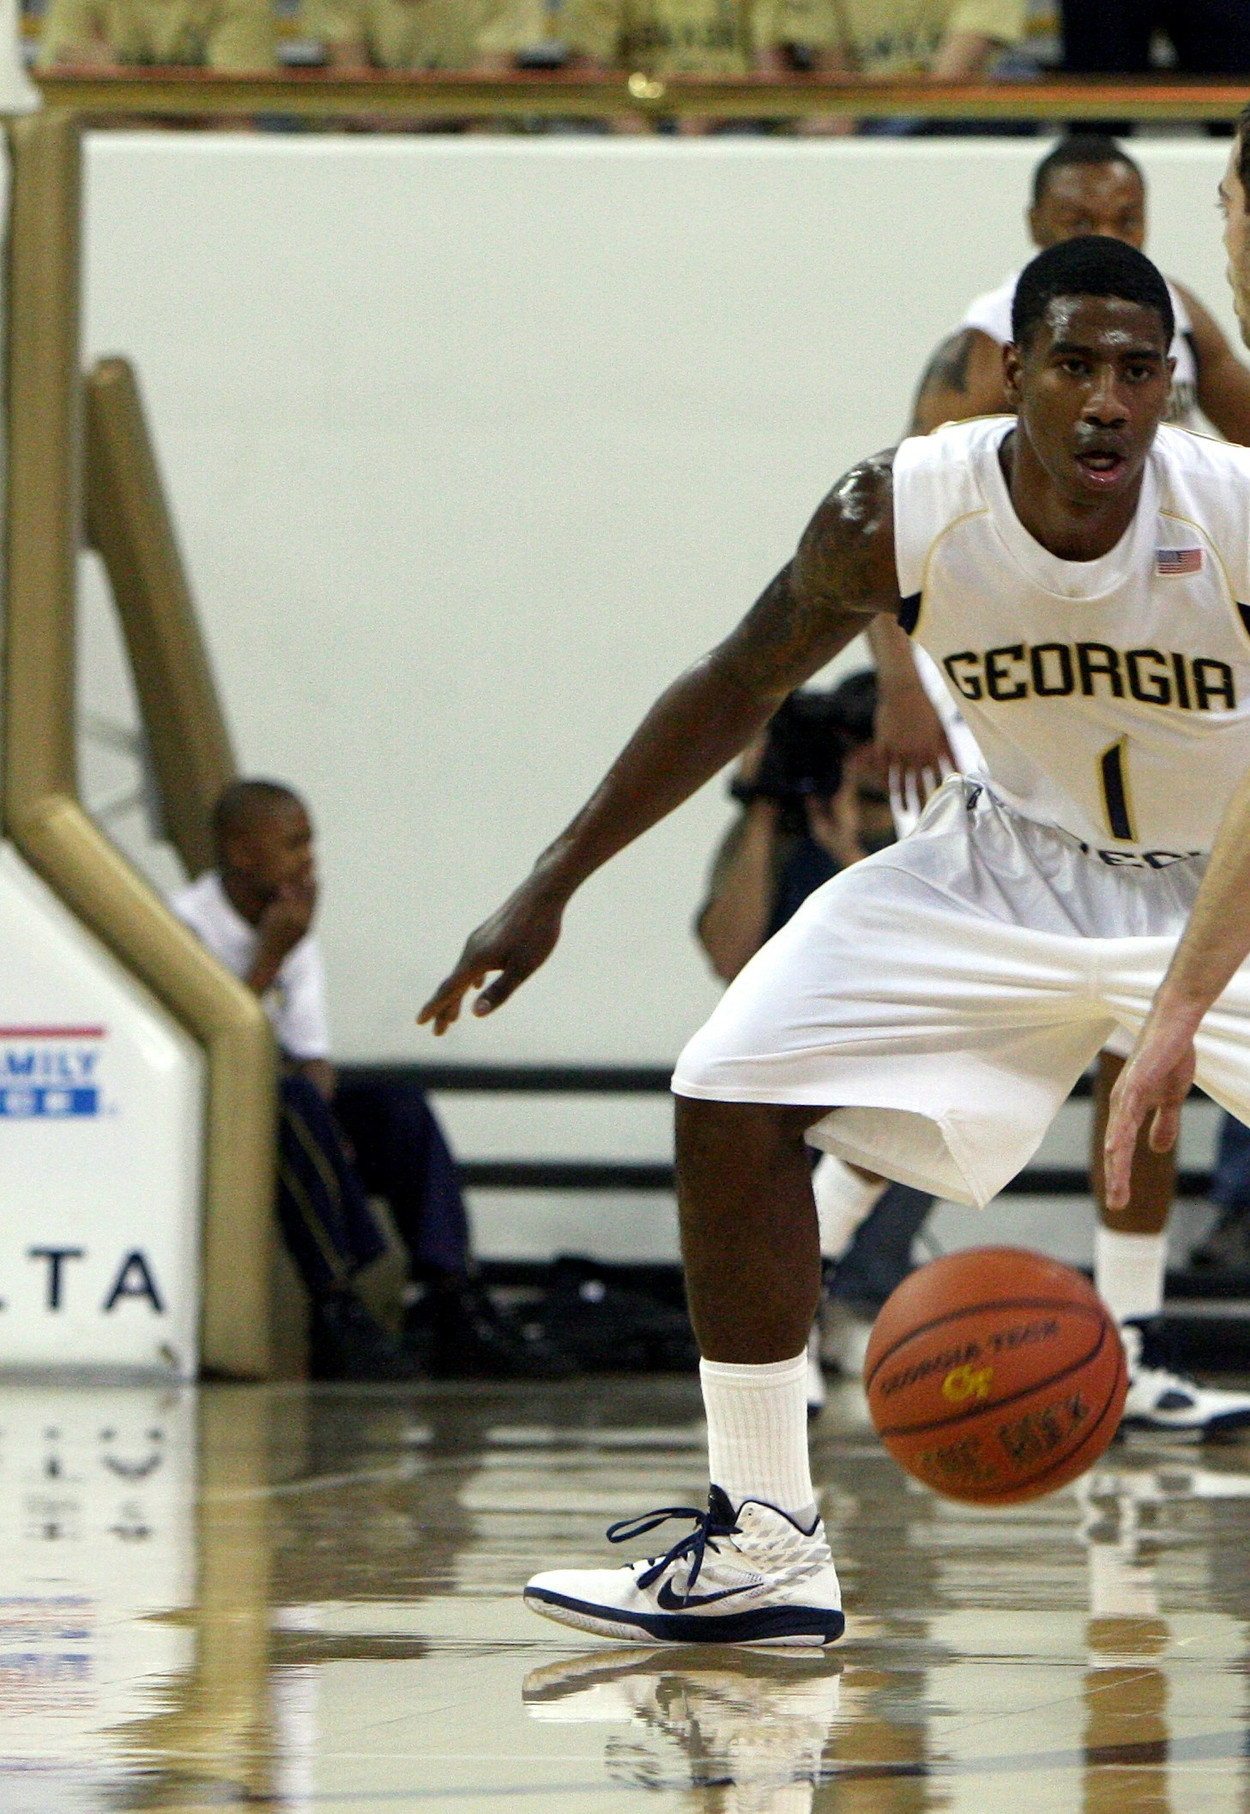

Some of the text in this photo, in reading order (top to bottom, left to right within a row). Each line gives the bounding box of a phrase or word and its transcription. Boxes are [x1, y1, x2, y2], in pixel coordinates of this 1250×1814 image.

[943, 641, 1237, 711] GEORGIA
[1097, 733, 1139, 844] 1
[0, 1050, 98, 1077] MILY
[0, 1246, 165, 1313] TA
